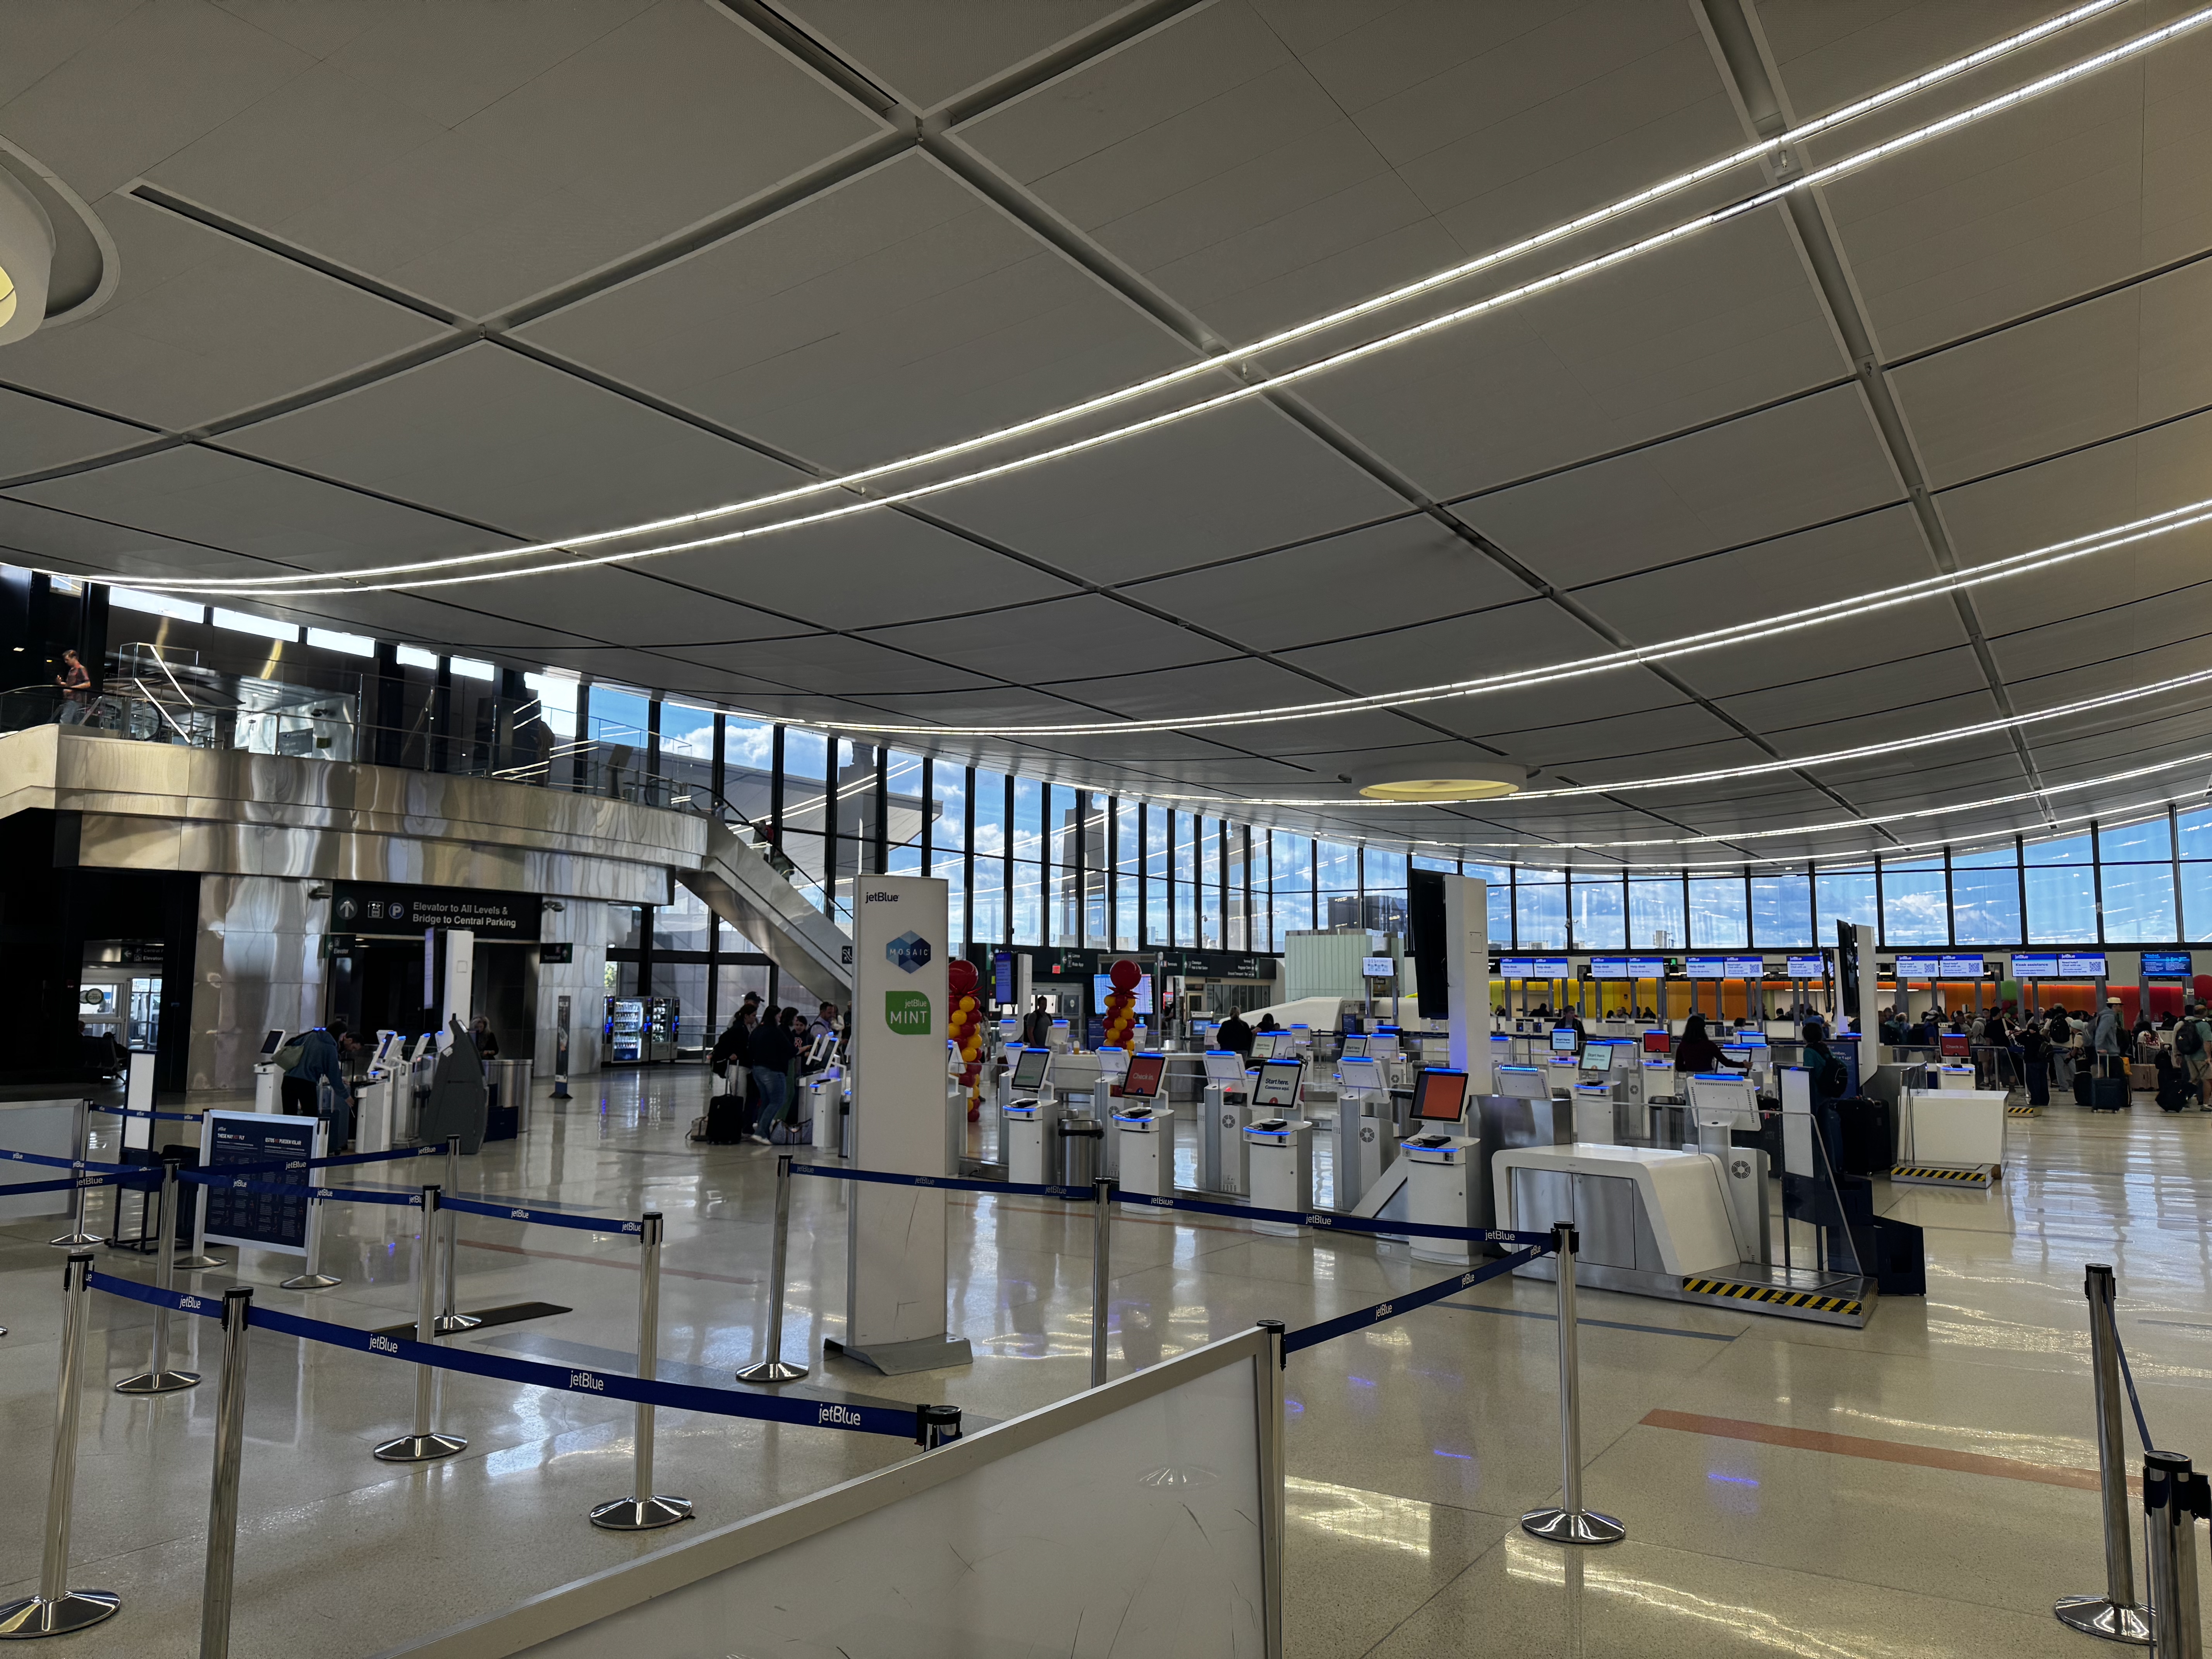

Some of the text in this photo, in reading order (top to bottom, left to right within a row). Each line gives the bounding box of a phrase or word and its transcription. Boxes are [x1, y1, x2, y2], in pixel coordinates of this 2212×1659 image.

[866, 892, 899, 903] jetBlue
[413, 902, 508, 915] Elevator to All Levels &
[413, 914, 517, 929] Bridge to Central Parking
[905, 999, 927, 1009] jetBlue
[890, 1011, 927, 1024] MINT
[418, 1147, 436, 1156] jetBlue
[285, 1161, 307, 1170] jetBlue
[797, 1165, 814, 1173] jetBlue
[76, 1177, 103, 1188] jetBlue
[233, 1179, 247, 1188] jetBlue
[915, 1176, 935, 1185] jetBlue
[317, 1188, 333, 1197] jetBlue
[1045, 1185, 1067, 1194] jetBlue
[1151, 1195, 1174, 1206] jetBlue
[511, 1208, 529, 1219] jetBlue
[1305, 1214, 1332, 1225] jetBlue
[1485, 1229, 1516, 1241] jetBlue
[1461, 1273, 1475, 1288] jetBlue
[179, 1295, 201, 1309] jetBlue
[1376, 1303, 1393, 1321] jetBlue
[369, 1334, 398, 1353] jetBlue
[569, 1370, 604, 1391] jetBlue
[818, 1403, 861, 1426] jetBlue
